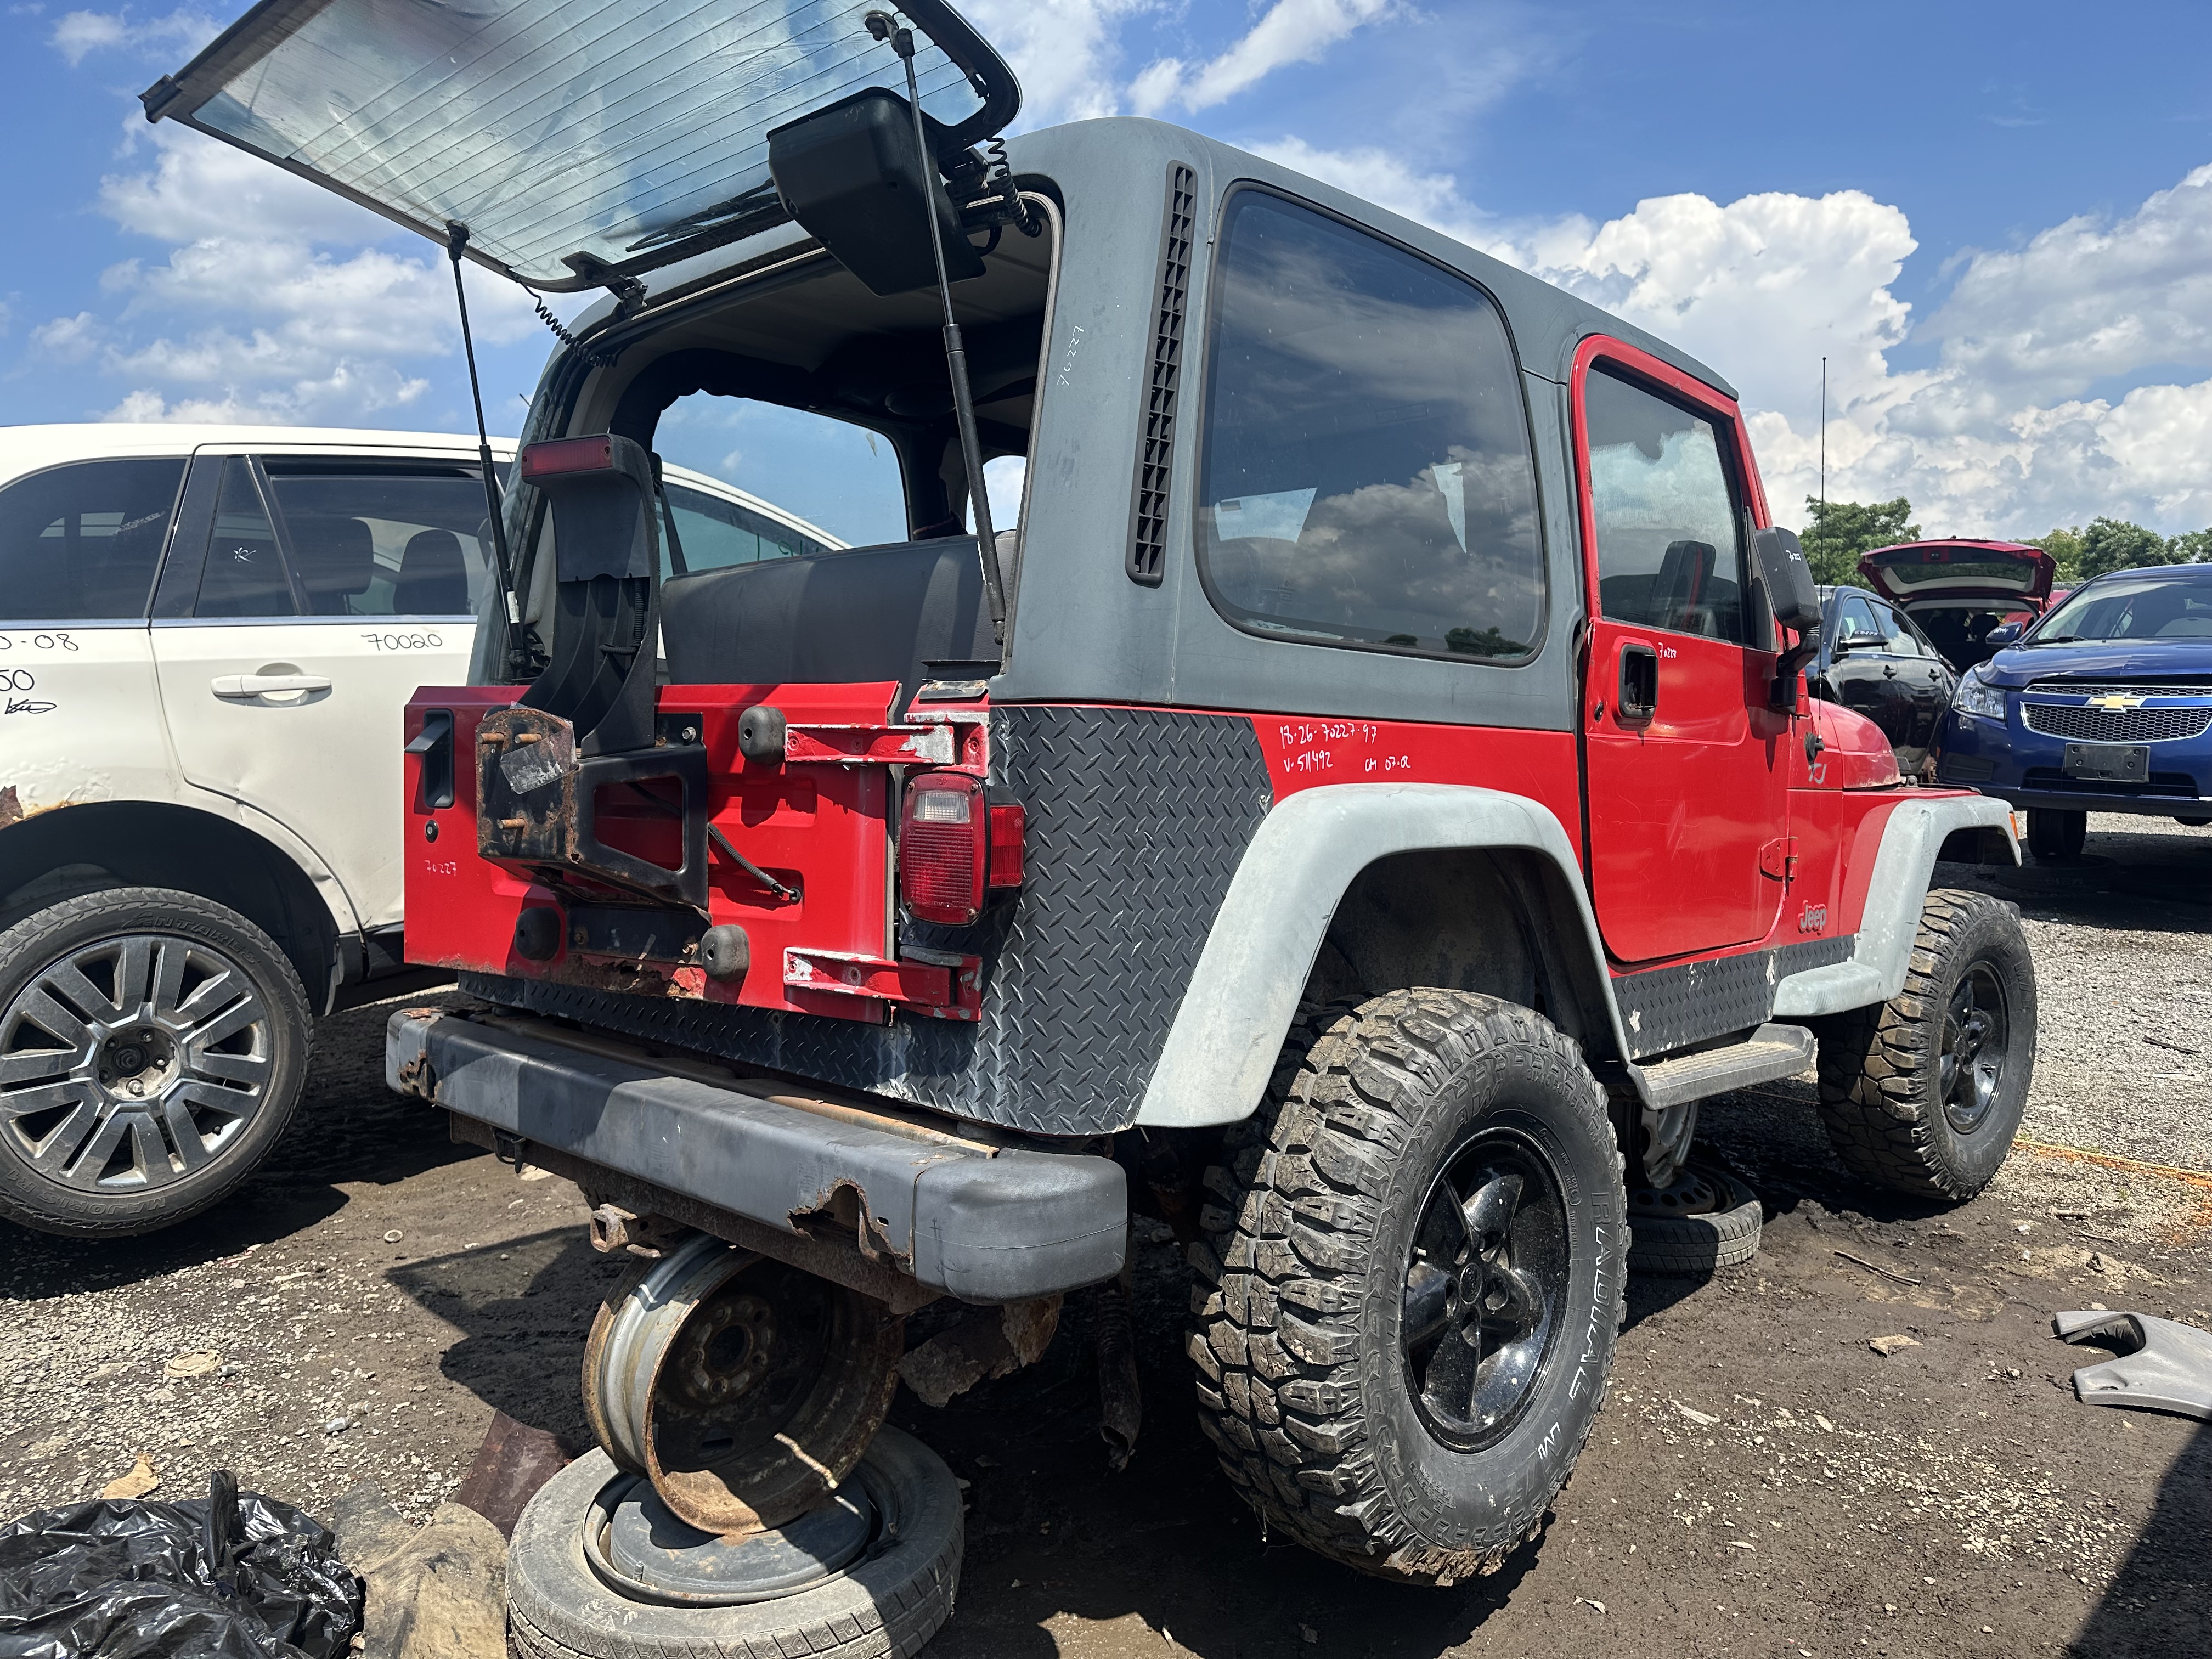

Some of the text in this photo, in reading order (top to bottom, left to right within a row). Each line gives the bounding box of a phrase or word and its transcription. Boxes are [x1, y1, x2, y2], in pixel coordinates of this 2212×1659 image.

[1057, 325, 1085, 386] 70227
[360, 634, 443, 651] 70020
[1808, 763, 1827, 785] TJ
[424, 859, 456, 877] 70227
[1799, 901, 1827, 932] Jeep
[37, 1190, 167, 1216] MAJORIS
[1568, 1192, 1612, 1402] RADIAL
